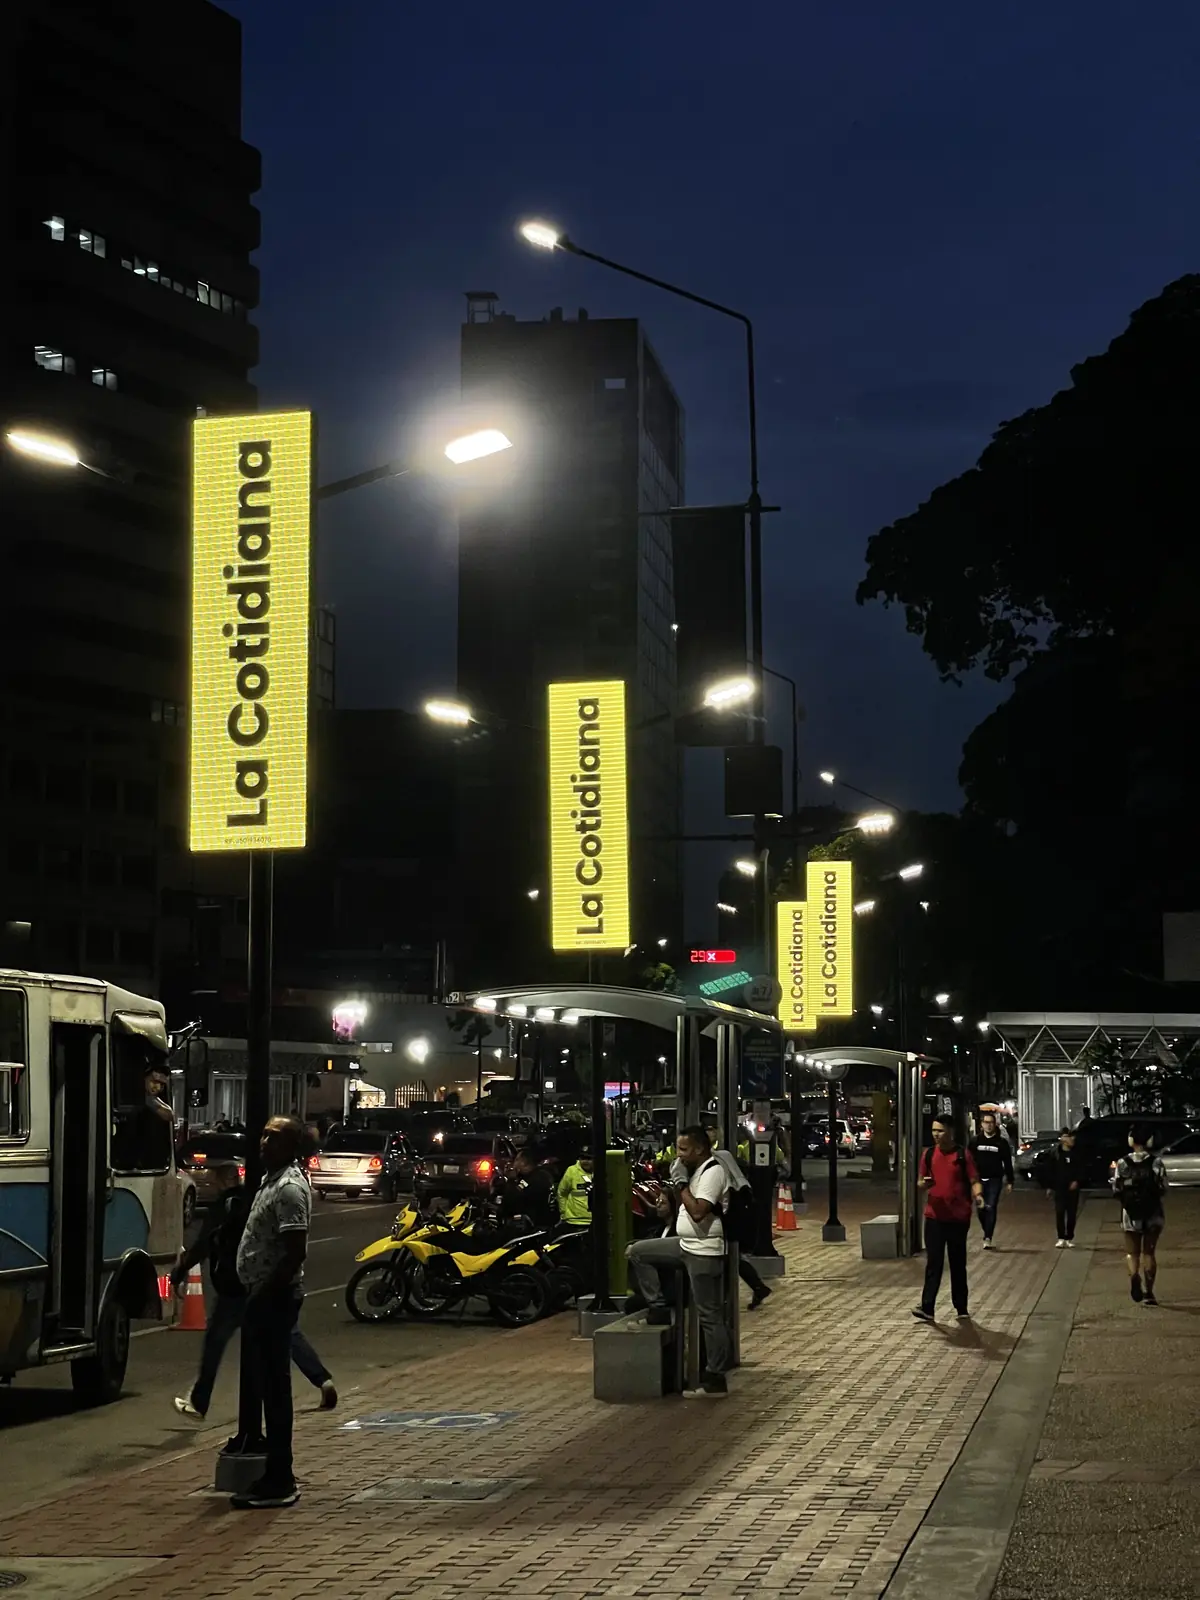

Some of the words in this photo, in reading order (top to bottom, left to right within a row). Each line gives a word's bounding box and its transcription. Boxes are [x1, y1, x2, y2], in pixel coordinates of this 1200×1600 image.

[223, 440, 271, 747] Cotidiana
[227, 759, 268, 828] La
[570, 698, 603, 886] Cotidiana
[576, 893, 604, 935] La
[819, 871, 837, 979] Cotidiana
[788, 910, 804, 999] Cotidiana
[791, 1003, 804, 1022] La
[821, 983, 837, 1007] La
